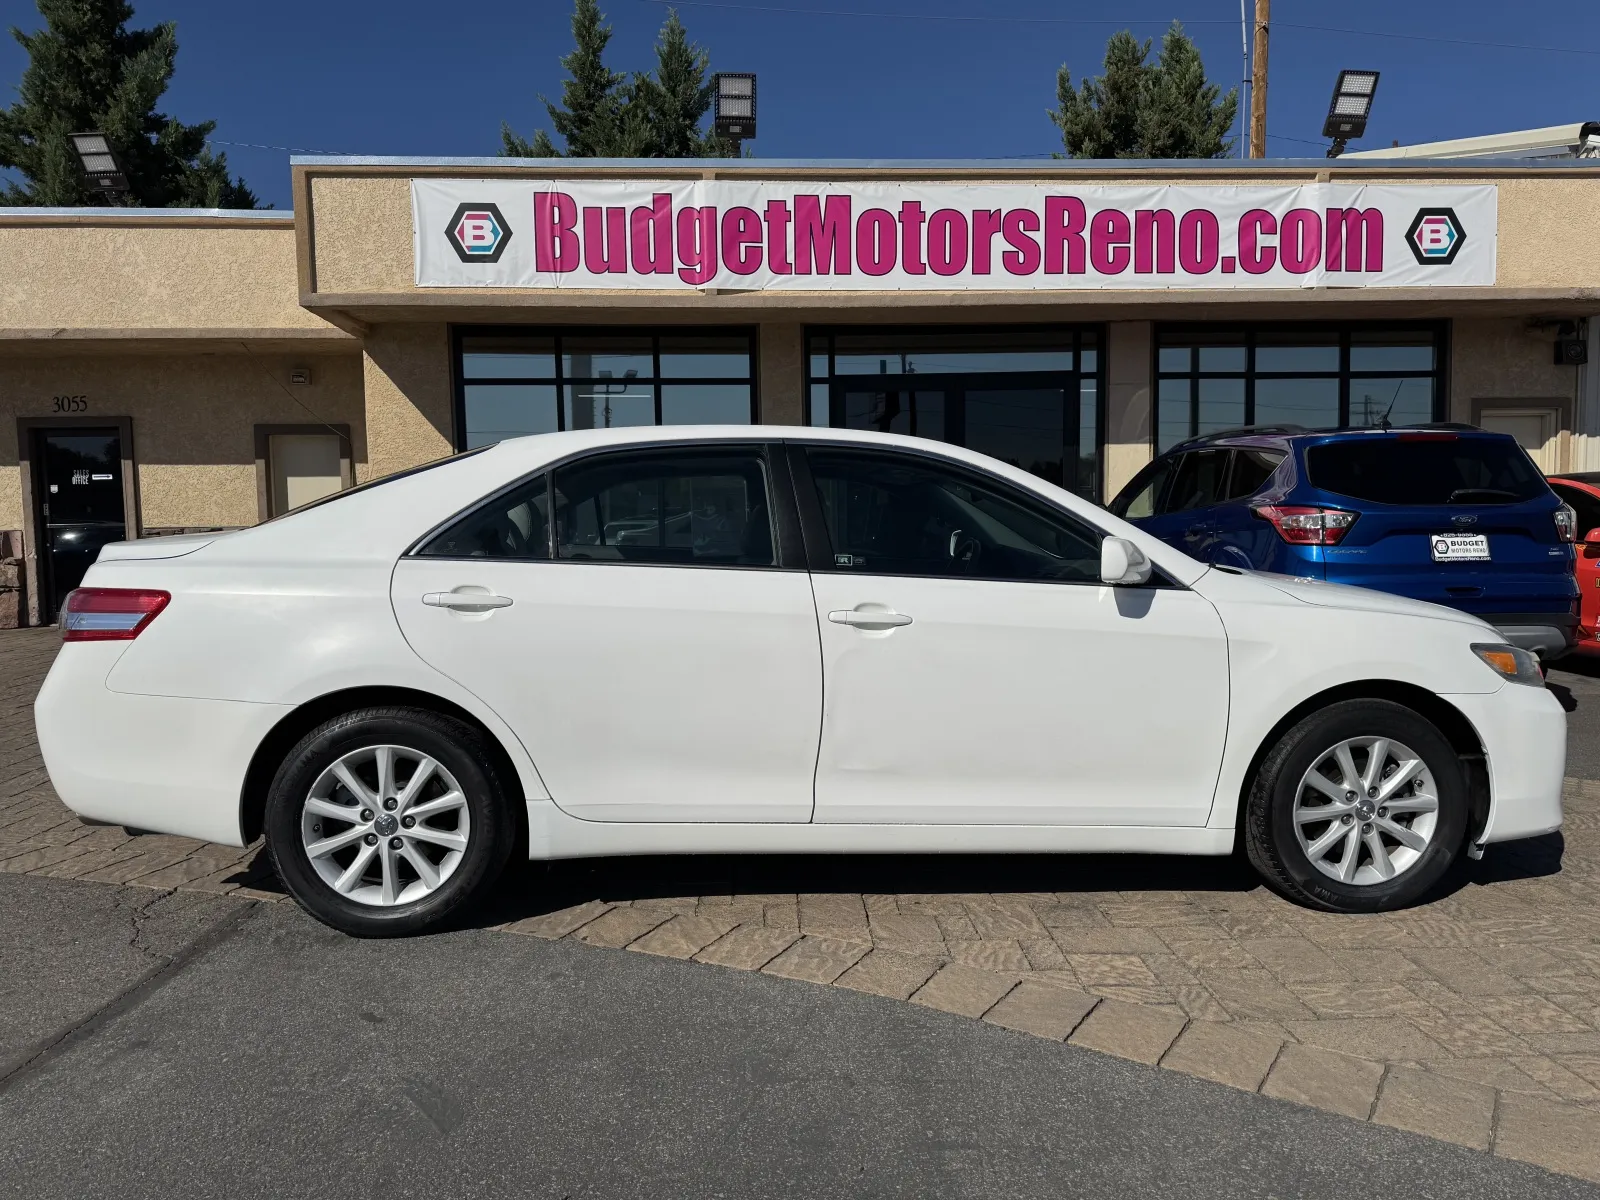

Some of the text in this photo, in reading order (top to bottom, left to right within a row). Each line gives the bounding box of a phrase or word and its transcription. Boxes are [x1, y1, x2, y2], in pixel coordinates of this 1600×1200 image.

[533, 191, 1384, 285] BudgetMotorsReno.com
[52, 395, 88, 412] 3055
[73, 469, 89, 477] SALES
[72, 476, 89, 485] OFFICE
